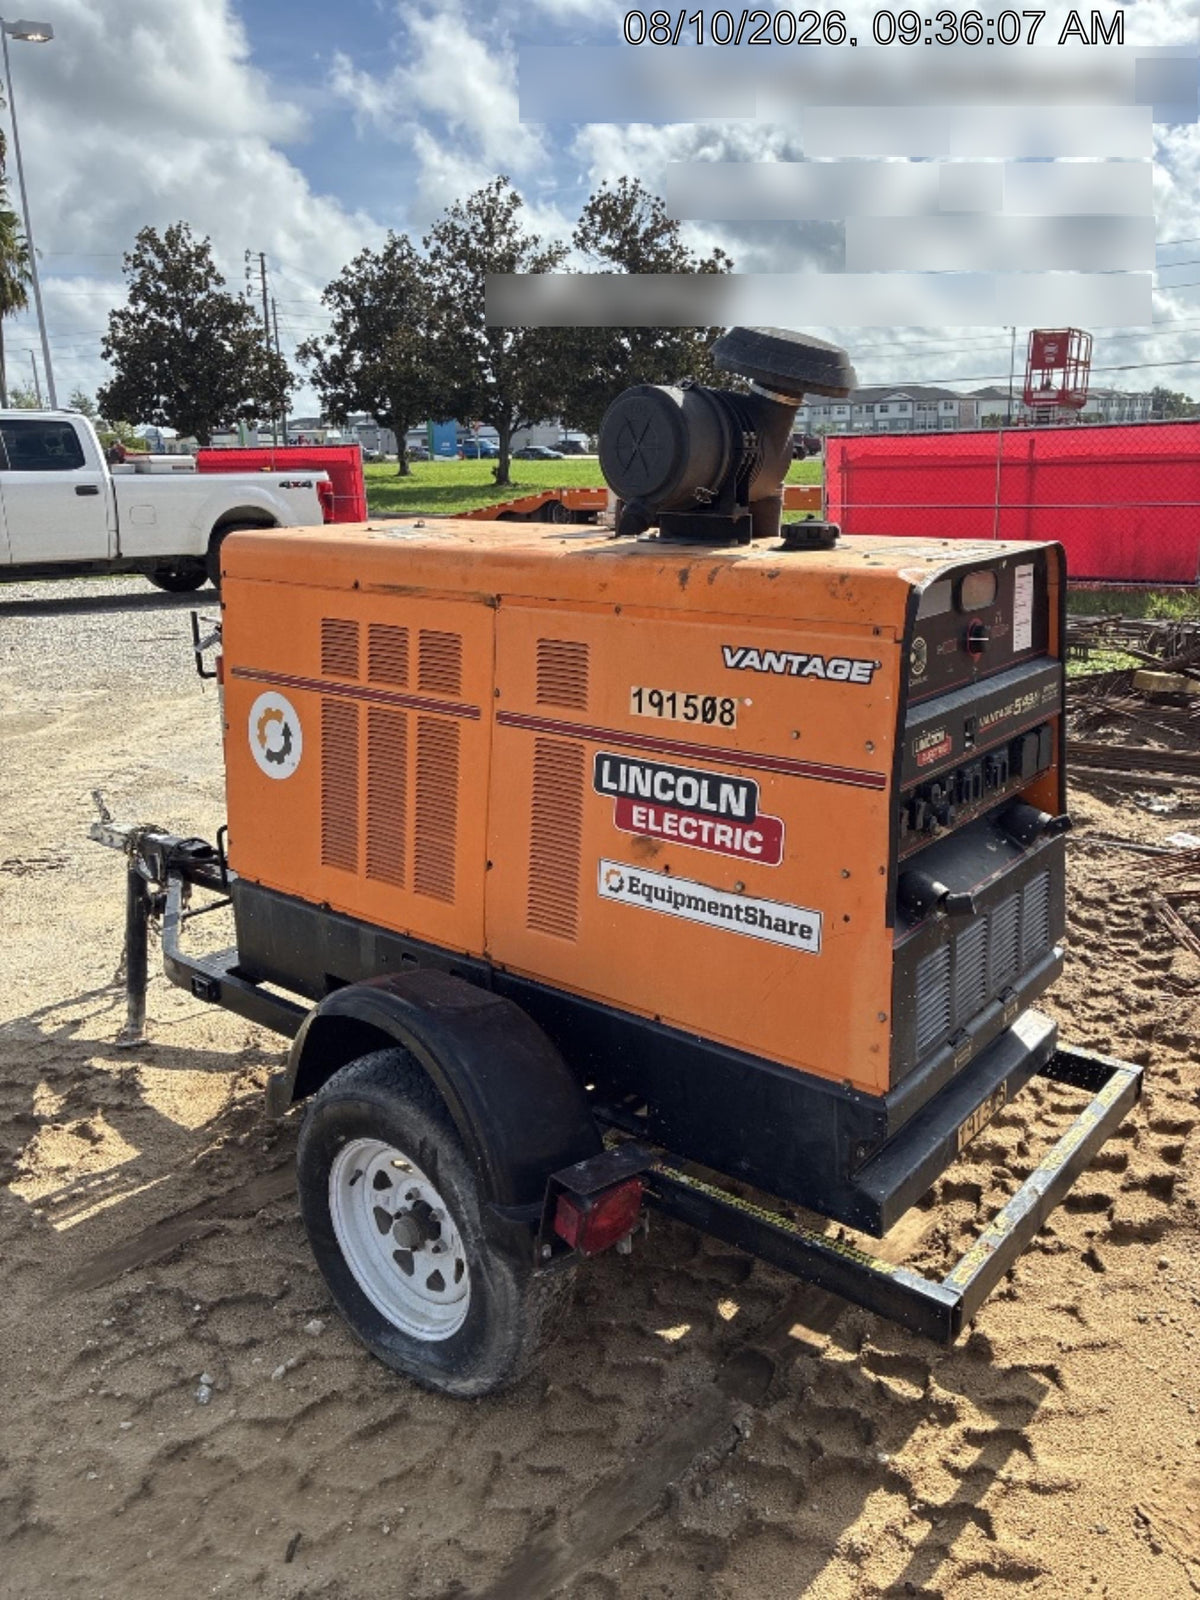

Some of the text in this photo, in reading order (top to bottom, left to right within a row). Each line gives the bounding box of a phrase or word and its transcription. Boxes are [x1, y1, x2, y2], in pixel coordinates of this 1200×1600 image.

[721, 646, 874, 684] VANTAGE
[632, 687, 736, 726] 191508
[601, 760, 748, 817] LINCOLN
[631, 805, 763, 855] ELECTRIC
[627, 876, 813, 940] EquipmentShare
